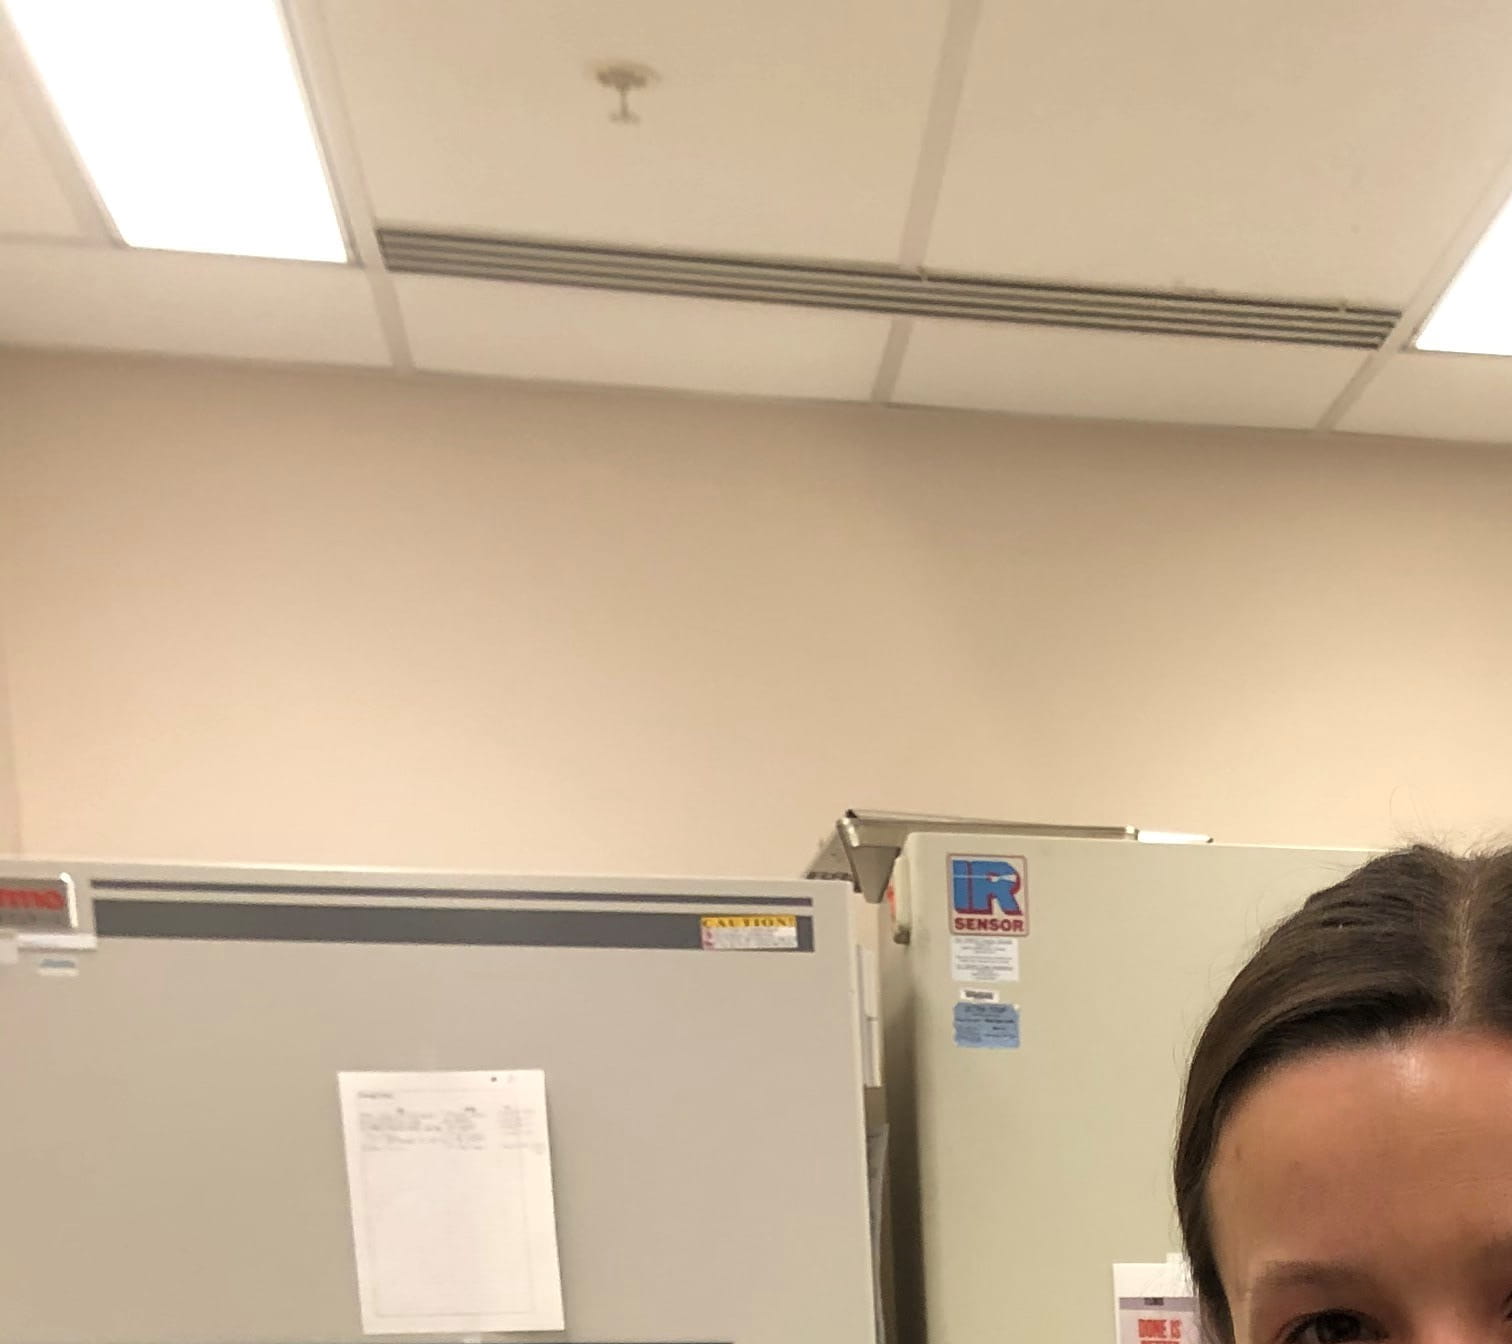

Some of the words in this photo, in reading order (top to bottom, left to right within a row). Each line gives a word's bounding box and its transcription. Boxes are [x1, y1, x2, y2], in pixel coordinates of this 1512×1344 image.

[953, 860, 1023, 916] IR
[955, 918, 1024, 931] SENSOR
[1170, 1319, 1181, 1338] IS
